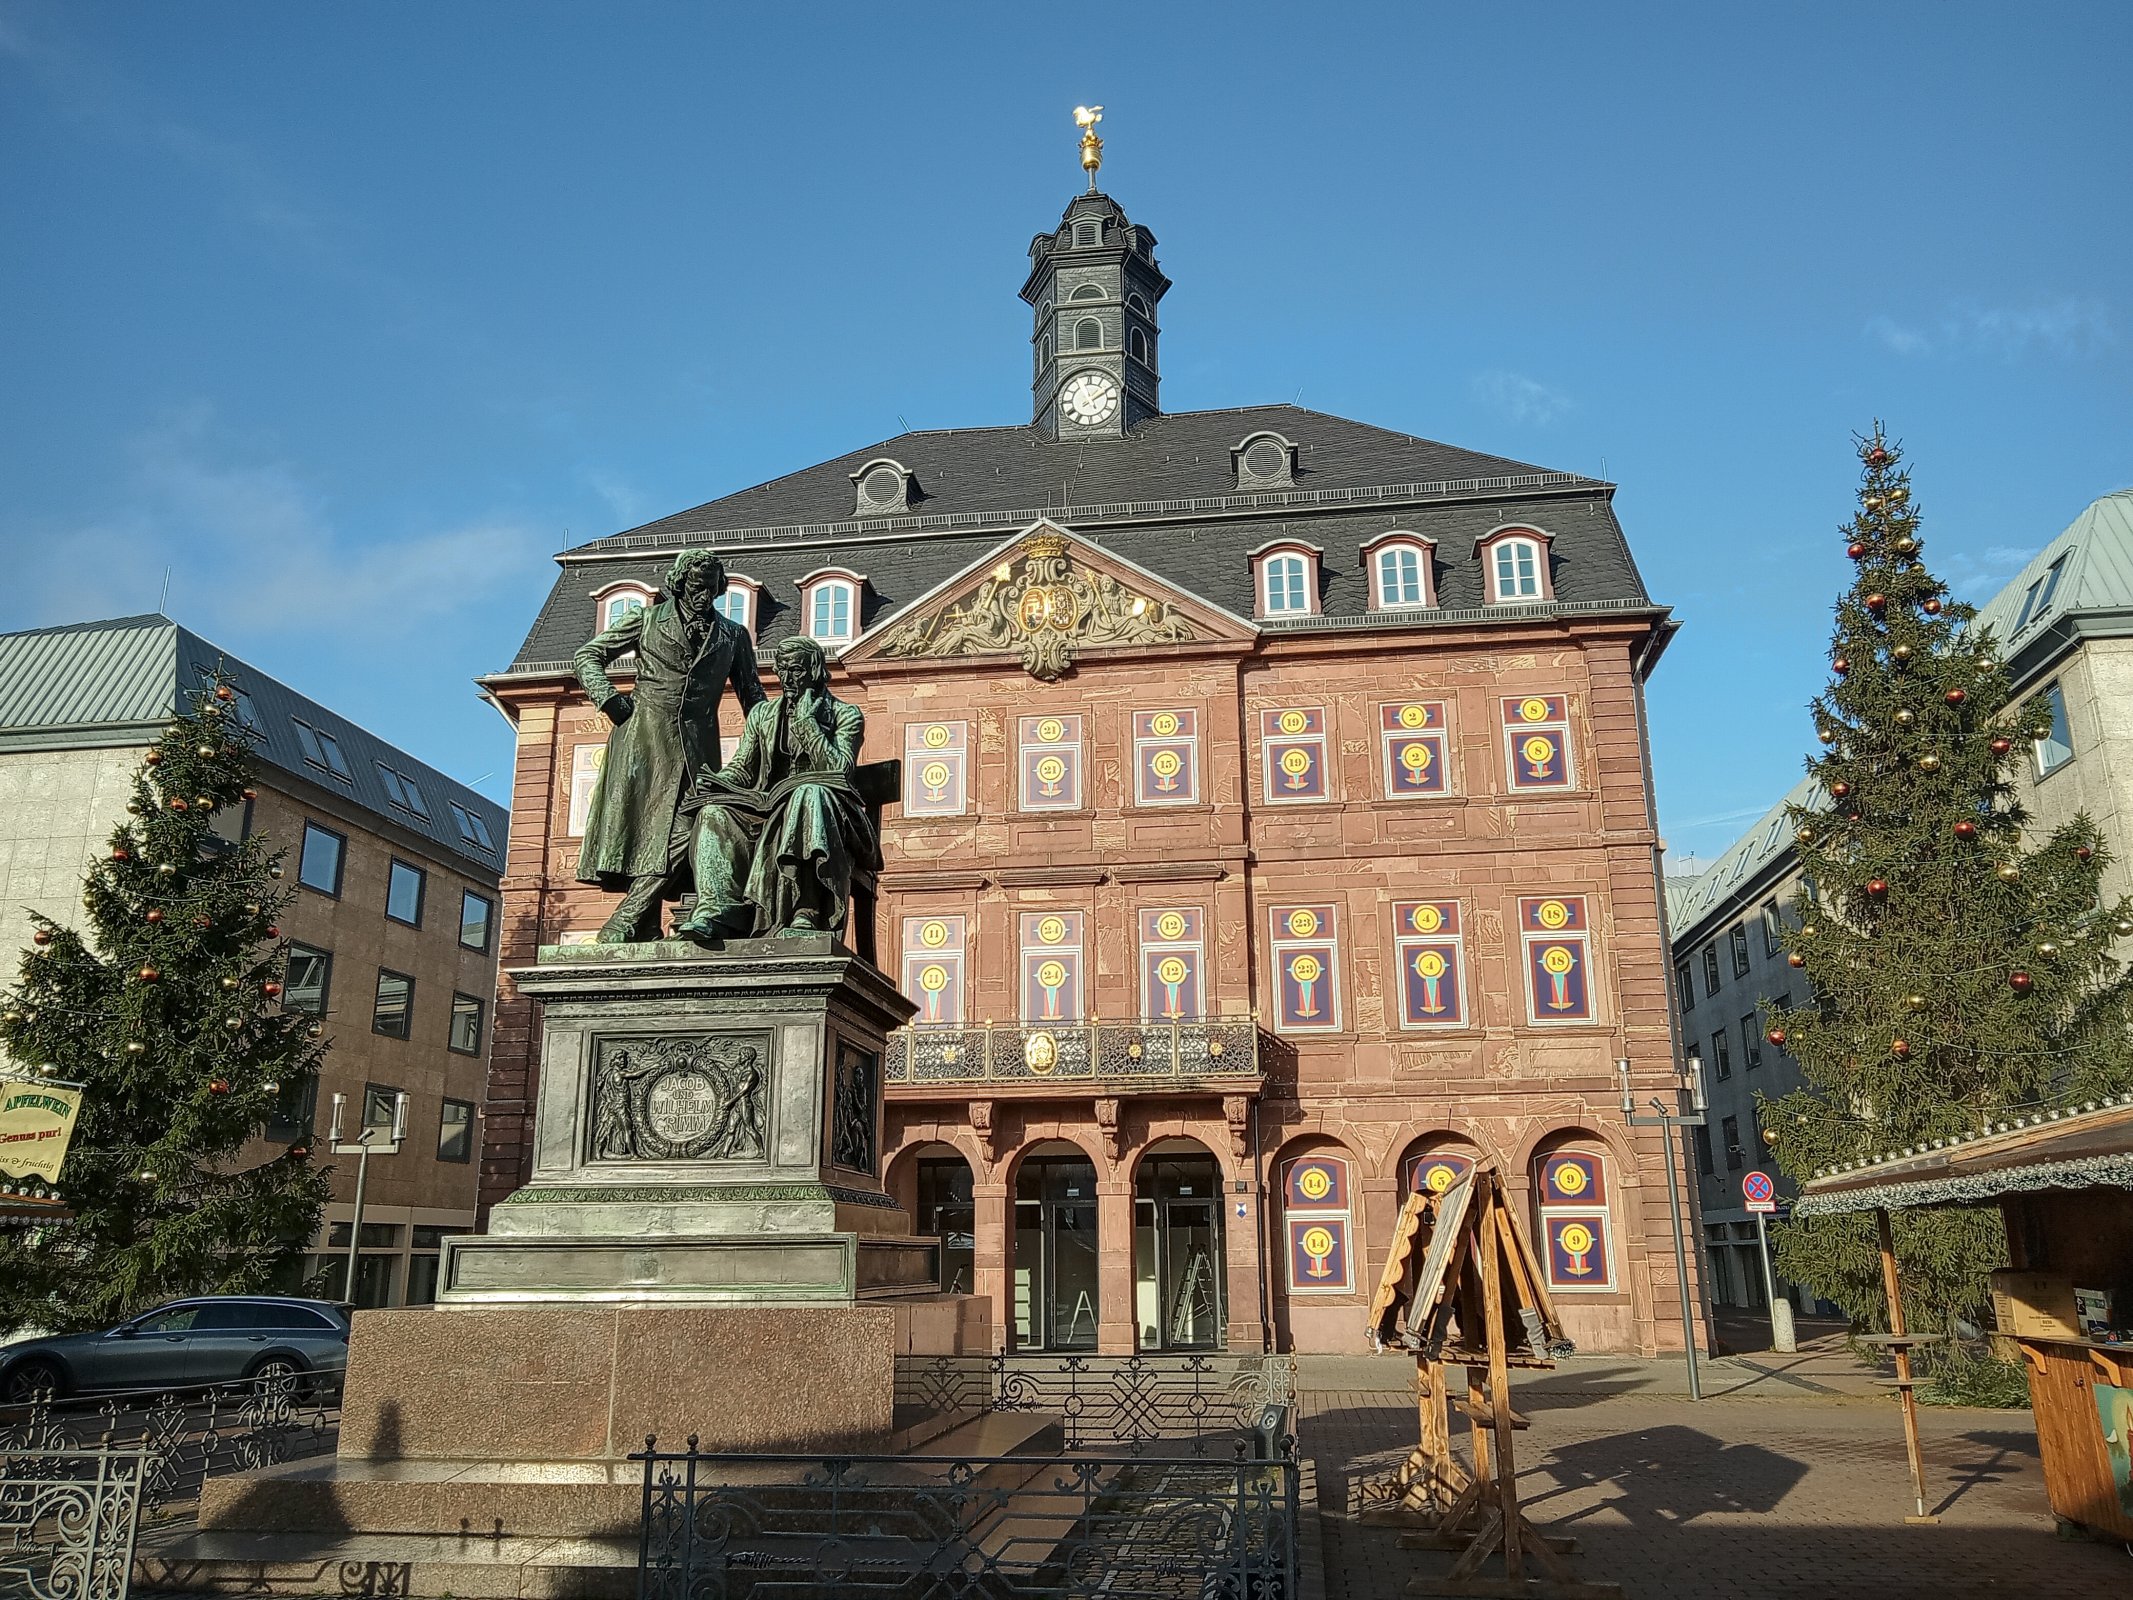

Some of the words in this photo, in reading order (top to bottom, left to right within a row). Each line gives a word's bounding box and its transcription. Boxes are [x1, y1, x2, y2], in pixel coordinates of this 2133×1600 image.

[1530, 705, 1538, 714] 8
[1408, 712, 1417, 721] 2
[1159, 720, 1171, 729] 15
[1287, 718, 1300, 727] 19
[1044, 725, 1057, 735] 21
[931, 732, 943, 741] 10
[1534, 746, 1542, 755] 8
[1411, 752, 1420, 761] 2
[1160, 760, 1172, 769] 15
[1289, 758, 1302, 767] 19
[1044, 765, 1057, 775] 21
[930, 771, 942, 780] 10
[1422, 914, 1430, 923] 4
[1547, 909, 1560, 919] 18
[1165, 921, 1178, 930] 12
[1295, 918, 1311, 928] 23
[1426, 960, 1433, 970] 4
[1551, 955, 1564, 966] 18
[1166, 966, 1179, 976] 12
[1298, 964, 1314, 974] 23
[662, 1077, 705, 1090] JACOB
[672, 1091, 693, 1099] UND
[3, 1095, 72, 1120] APFELWEIN
[651, 1098, 714, 1114] WILHELM
[655, 1115, 706, 1135] GRIMM
[0, 1132, 36, 1144] Genuss
[38, 1127, 62, 1142] pur!
[11, 1157, 21, 1165] &
[17, 1158, 54, 1172] fruchtig
[1308, 1178, 1322, 1189] 14
[1438, 1176, 1445, 1186] 5
[1566, 1174, 1575, 1184] 9
[1311, 1237, 1325, 1248] 14
[1572, 1235, 1581, 1245] 9
